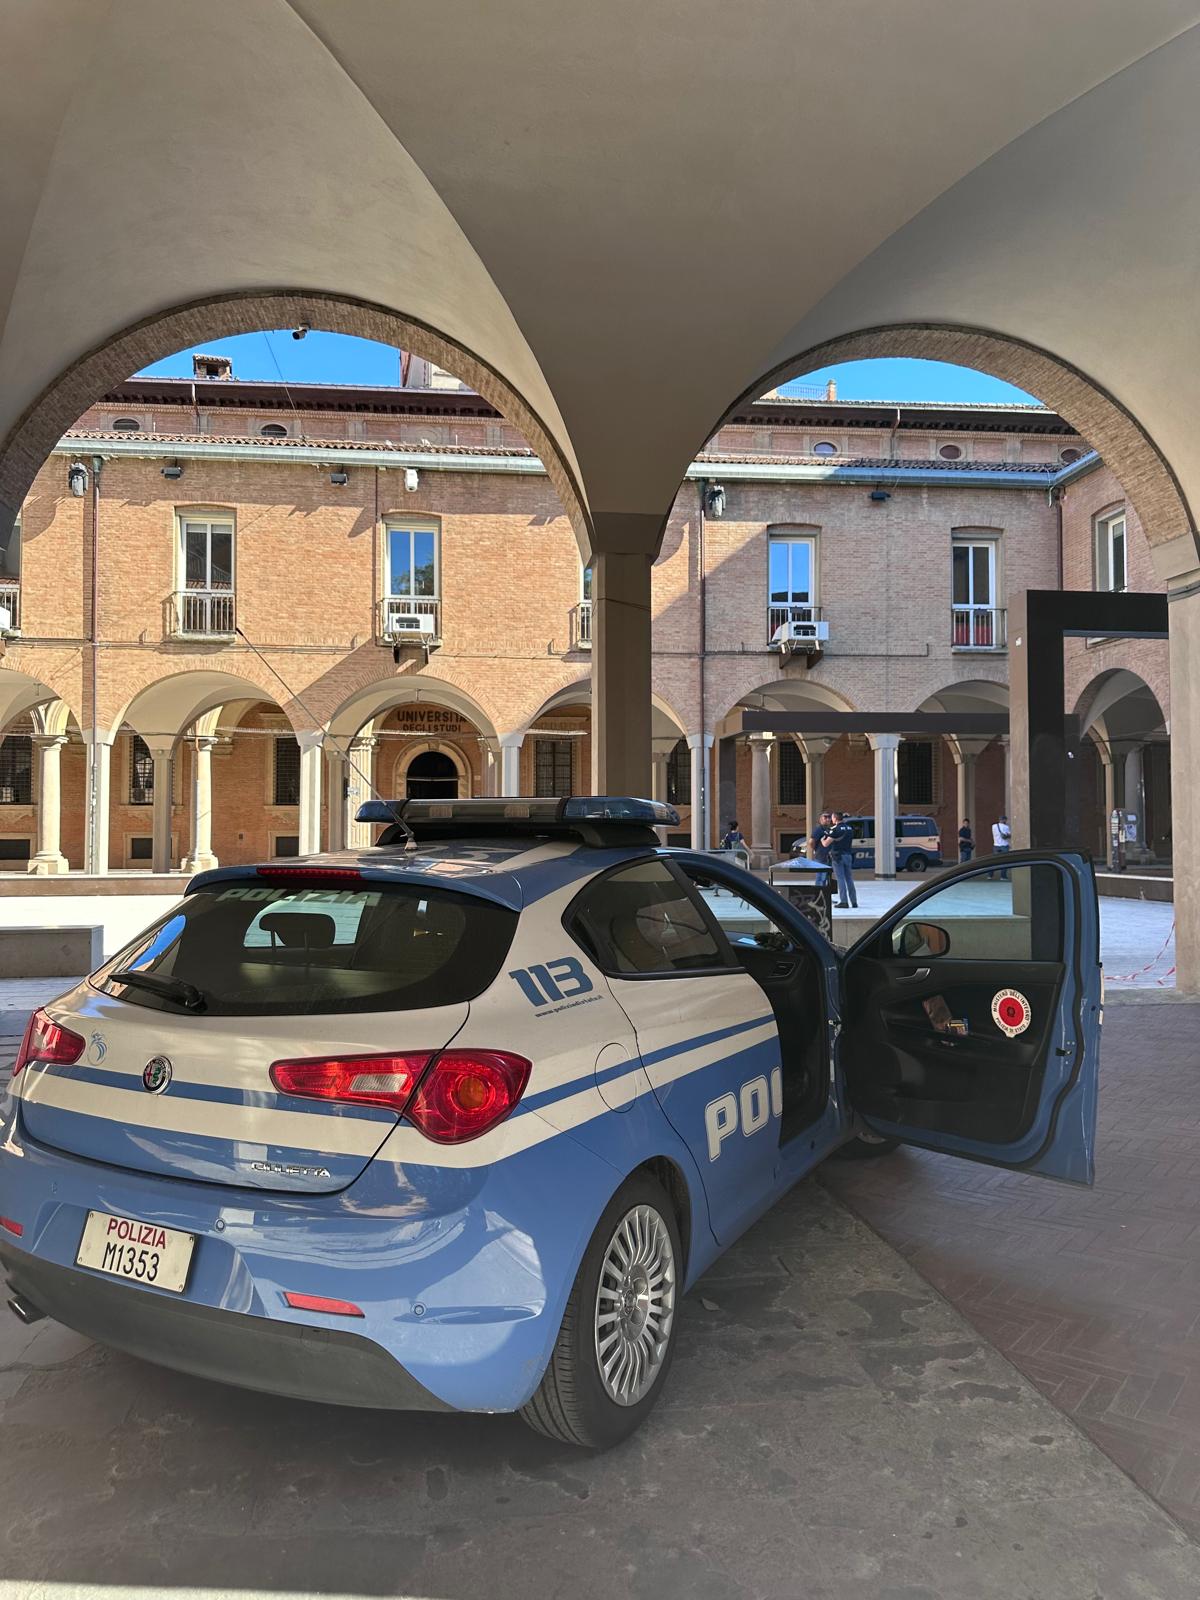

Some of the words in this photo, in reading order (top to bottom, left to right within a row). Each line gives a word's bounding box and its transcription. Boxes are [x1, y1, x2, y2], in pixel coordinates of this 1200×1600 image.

[403, 723, 431, 732] DEGLI
[433, 724, 461, 732] STUDI
[215, 888, 383, 907] POLIZIA
[508, 956, 594, 1007] 113
[107, 1218, 166, 1249] POLIZIA
[102, 1242, 160, 1281] M1353
